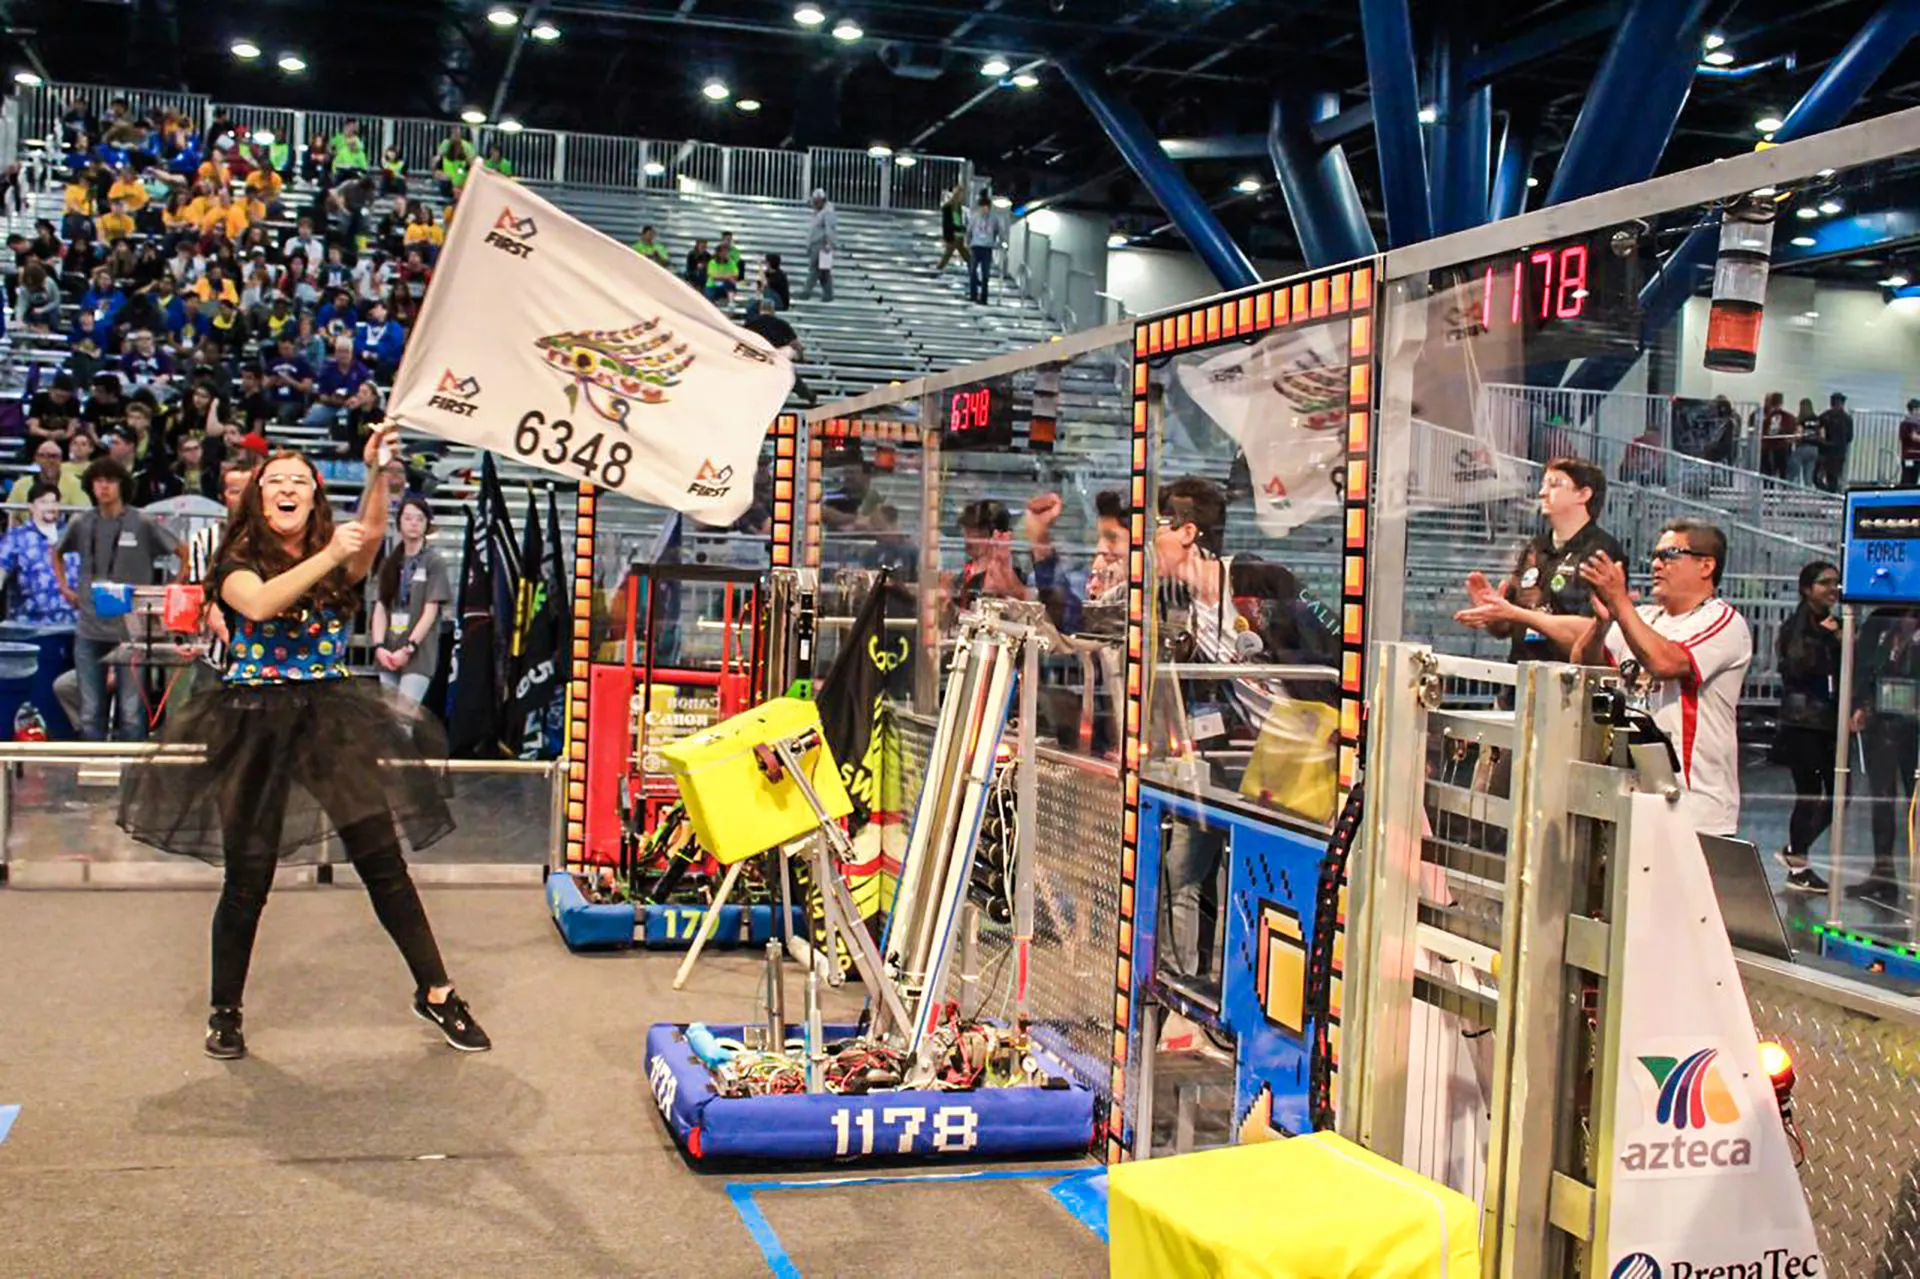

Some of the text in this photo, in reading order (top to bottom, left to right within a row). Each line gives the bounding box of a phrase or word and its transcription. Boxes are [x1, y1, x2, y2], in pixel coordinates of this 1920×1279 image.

[484, 231, 534, 259] FIRST
[1481, 245, 1588, 329] 1178
[427, 395, 479, 417] FIRST
[950, 388, 991, 432] 6348
[513, 410, 633, 489] 6348
[686, 482, 732, 498] FIRST
[1867, 541, 1906, 563] FORCE
[830, 1105, 979, 1155] 1178
[1623, 1134, 1752, 1171] azteca
